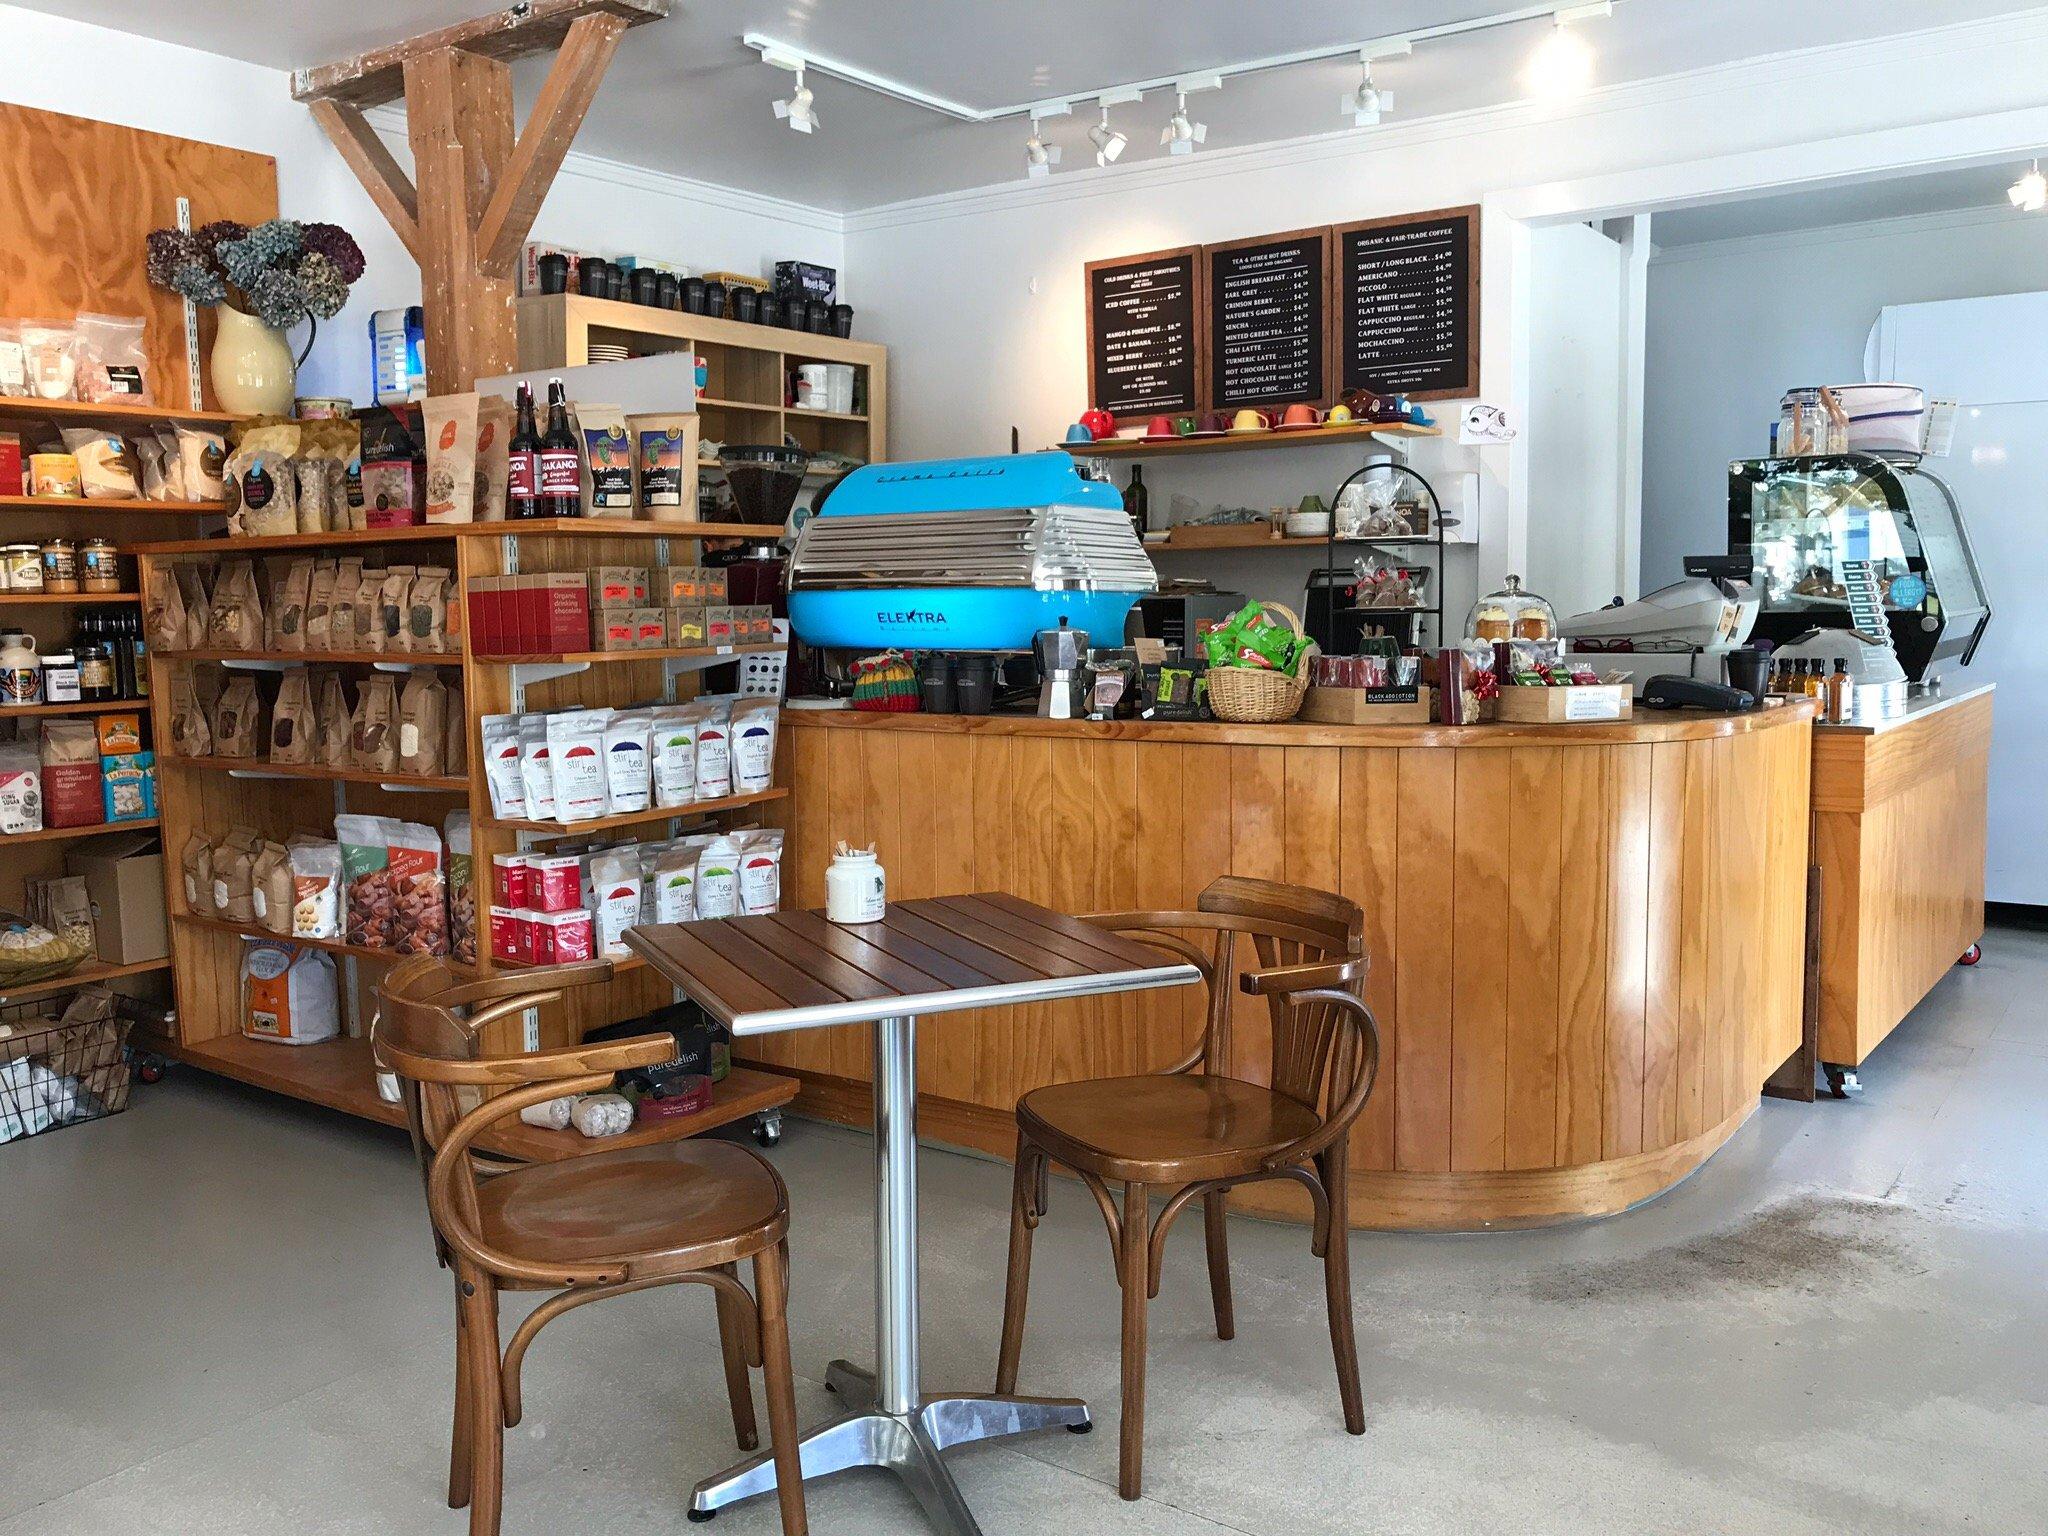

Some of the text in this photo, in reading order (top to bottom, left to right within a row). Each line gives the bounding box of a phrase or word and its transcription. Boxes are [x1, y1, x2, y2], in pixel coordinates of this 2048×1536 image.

[1357, 238, 1384, 247] ORGANIC
[1428, 228, 1453, 237] COFFEE
[1250, 254, 1268, 262] OTHER
[1280, 250, 1301, 258] DRINKS
[1357, 261, 1381, 271] SHORT
[1386, 258, 1405, 267] LONG
[1406, 255, 1428, 264] BLACK
[1225, 280, 1251, 288] ENGLISH
[1252, 274, 1286, 285] BREAKFAST
[1357, 270, 1399, 282] AMERICANO
[1357, 283, 1388, 293] PICCOLO
[1225, 291, 1240, 299] EARL
[1242, 289, 1258, 297] GREY
[1358, 296, 1375, 304] FLAT
[1376, 293, 1399, 302] WHITE
[1120, 298, 1141, 307] COFFEE
[1225, 300, 1253, 310] CRIMSON
[1254, 298, 1274, 306] BERRY
[1225, 310, 1255, 320] NATURE'S
[1256, 307, 1281, 317] GARDEN
[1358, 307, 1376, 315] FLAT
[1377, 304, 1400, 313] WHITE
[1358, 315, 1402, 326] CAPPUCCINO
[1225, 322, 1250, 331] SENCHA
[1358, 327, 1402, 337] CAPPUCCINO
[1106, 331, 1127, 339] MANGO
[1132, 326, 1161, 336] PINEAPPLE
[1225, 333, 1249, 341] MINTED
[1250, 330, 1270, 338] GREEN
[1128, 340, 1152, 348] BANANA
[1358, 337, 1405, 348] MOCHACCINO
[1125, 352, 1144, 360] BERRY
[1225, 347, 1241, 355] CHAI
[1358, 352, 1380, 360] LATTE
[1226, 356, 1256, 365] TURMERIC
[1257, 354, 1277, 362] LATTE
[1107, 365, 1138, 374] BLUEBERRY
[1225, 368, 1239, 376] HOT
[1240, 364, 1277, 374] CHOCOLATE
[1240, 375, 1277, 385] CHOCOLATE
[1225, 389, 1246, 397] CHILLI
[1246, 387, 1260, 395] HOT
[554, 600, 578, 608] drinking
[878, 608, 947, 624] ELEKTRA
[700, 742, 726, 755] stir tea
[744, 738, 768, 752] stir tea
[614, 753, 643, 768] stir tea
[668, 748, 690, 762] stir tea
[502, 760, 516, 770] stir
[535, 759, 550, 768] stir
[566, 759, 597, 774] stir tea
[749, 869, 773, 882] stir tea
[703, 878, 732, 892] stir tea
[669, 889, 692, 903] stir tea
[610, 902, 636, 915] stir tea
